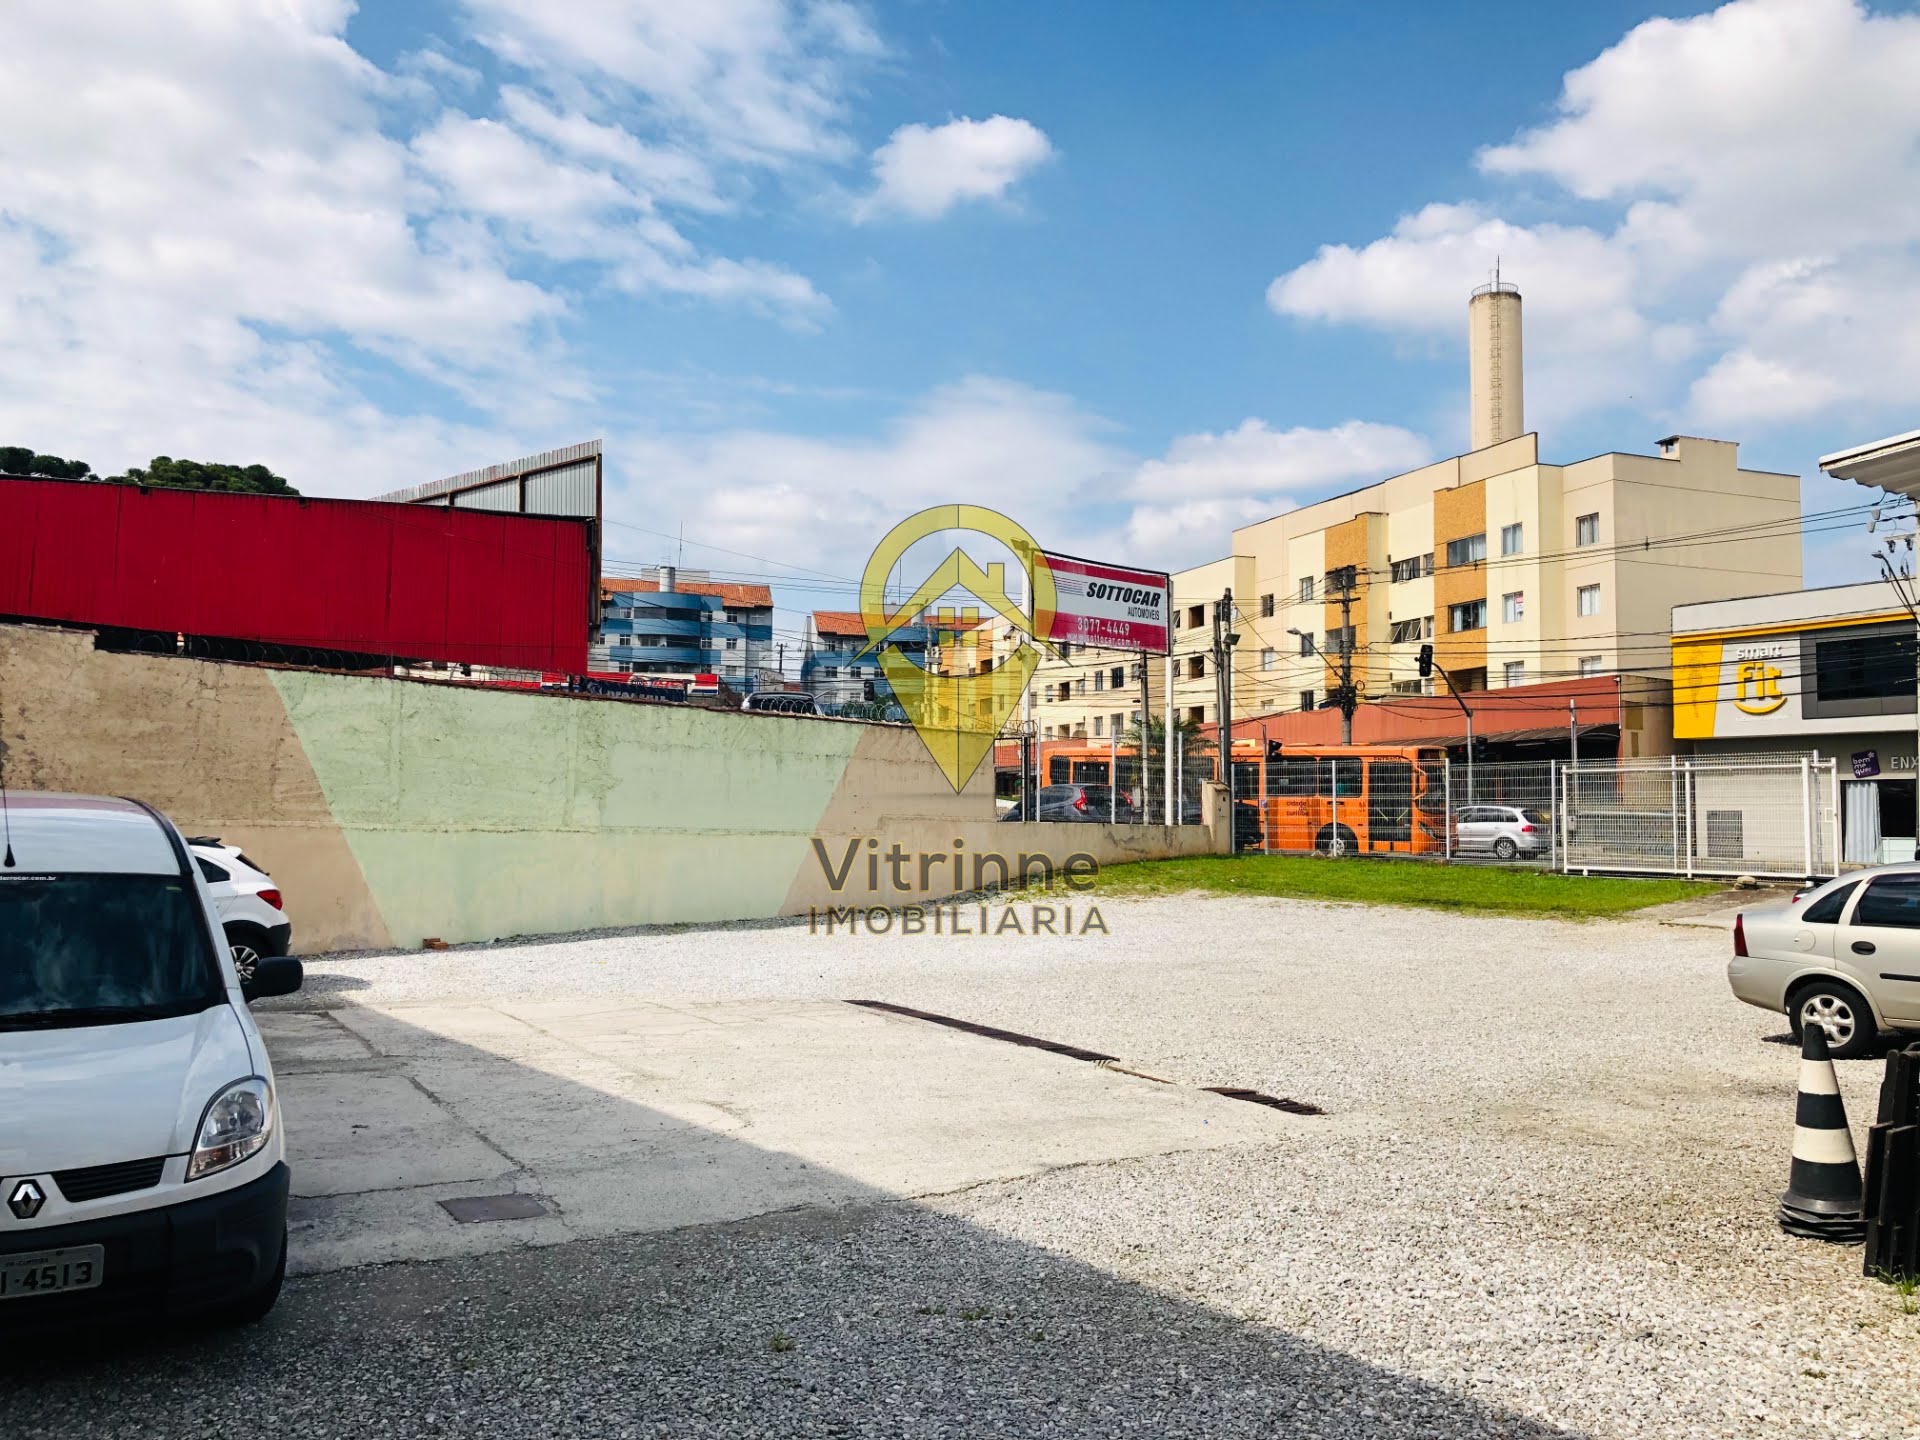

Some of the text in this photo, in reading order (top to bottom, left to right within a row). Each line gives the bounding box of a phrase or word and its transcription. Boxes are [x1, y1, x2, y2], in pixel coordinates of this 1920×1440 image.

[1086, 582, 1162, 607] SOTTOCAR
[1077, 616, 1130, 636] 3077-4449
[1737, 644, 1782, 659] smart
[1736, 661, 1782, 701] fit
[1852, 757, 1871, 765] bem
[1855, 767, 1872, 776] quer
